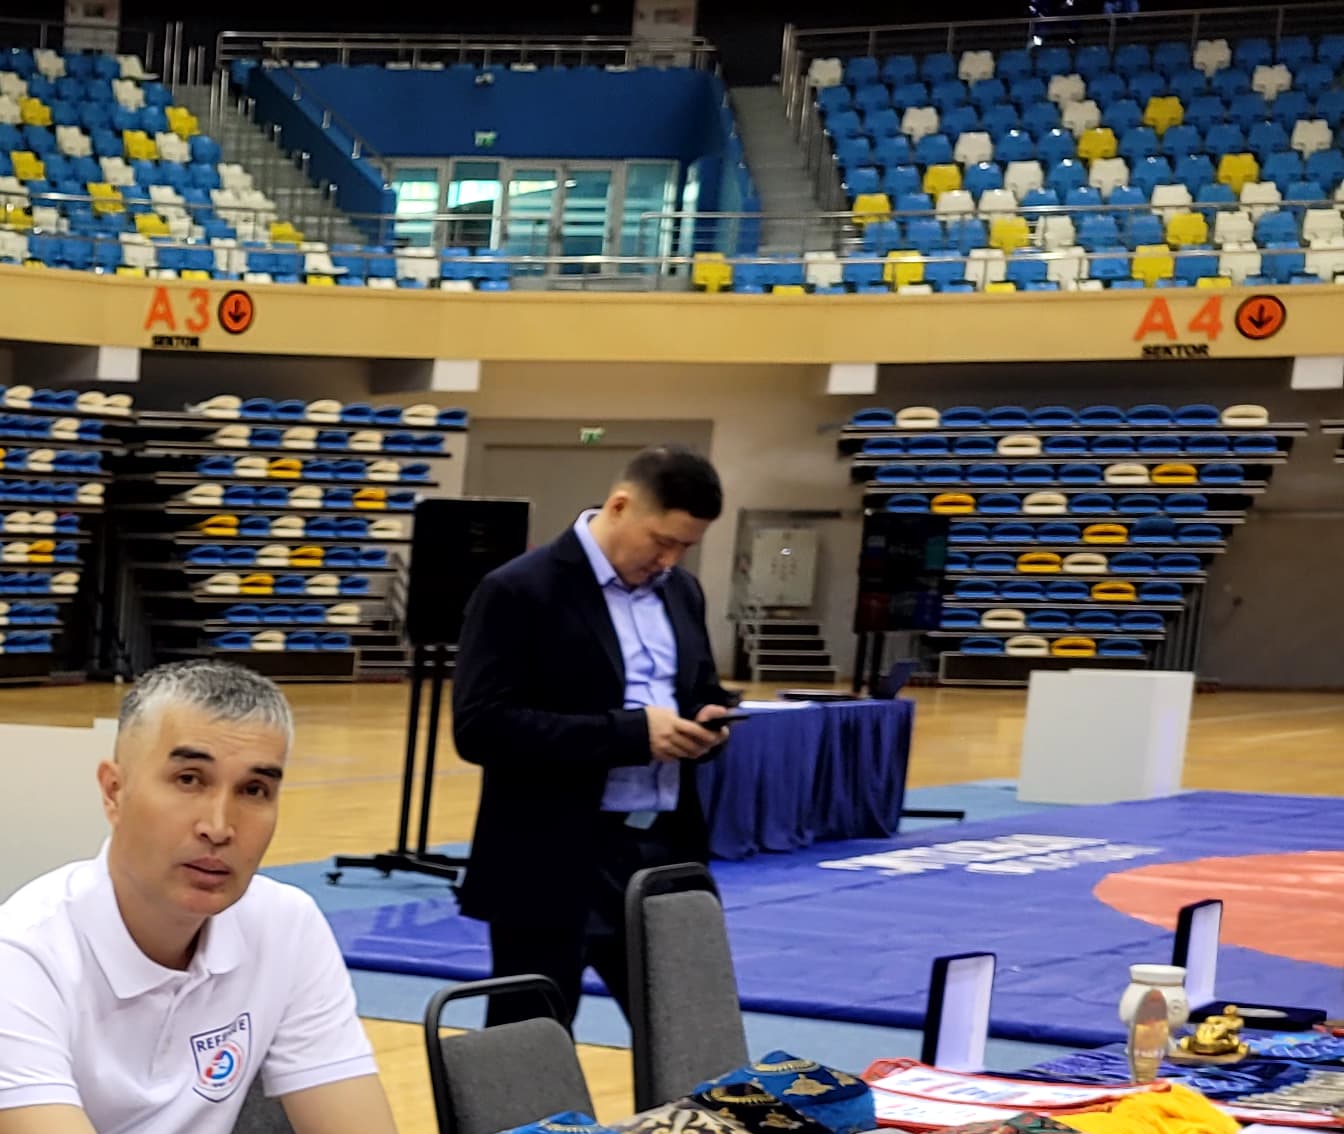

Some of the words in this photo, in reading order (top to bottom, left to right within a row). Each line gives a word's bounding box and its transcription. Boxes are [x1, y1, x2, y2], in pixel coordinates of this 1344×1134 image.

[143, 285, 210, 332] A3
[1132, 295, 1224, 342] A4
[1141, 344, 1210, 357] SEKTOR
